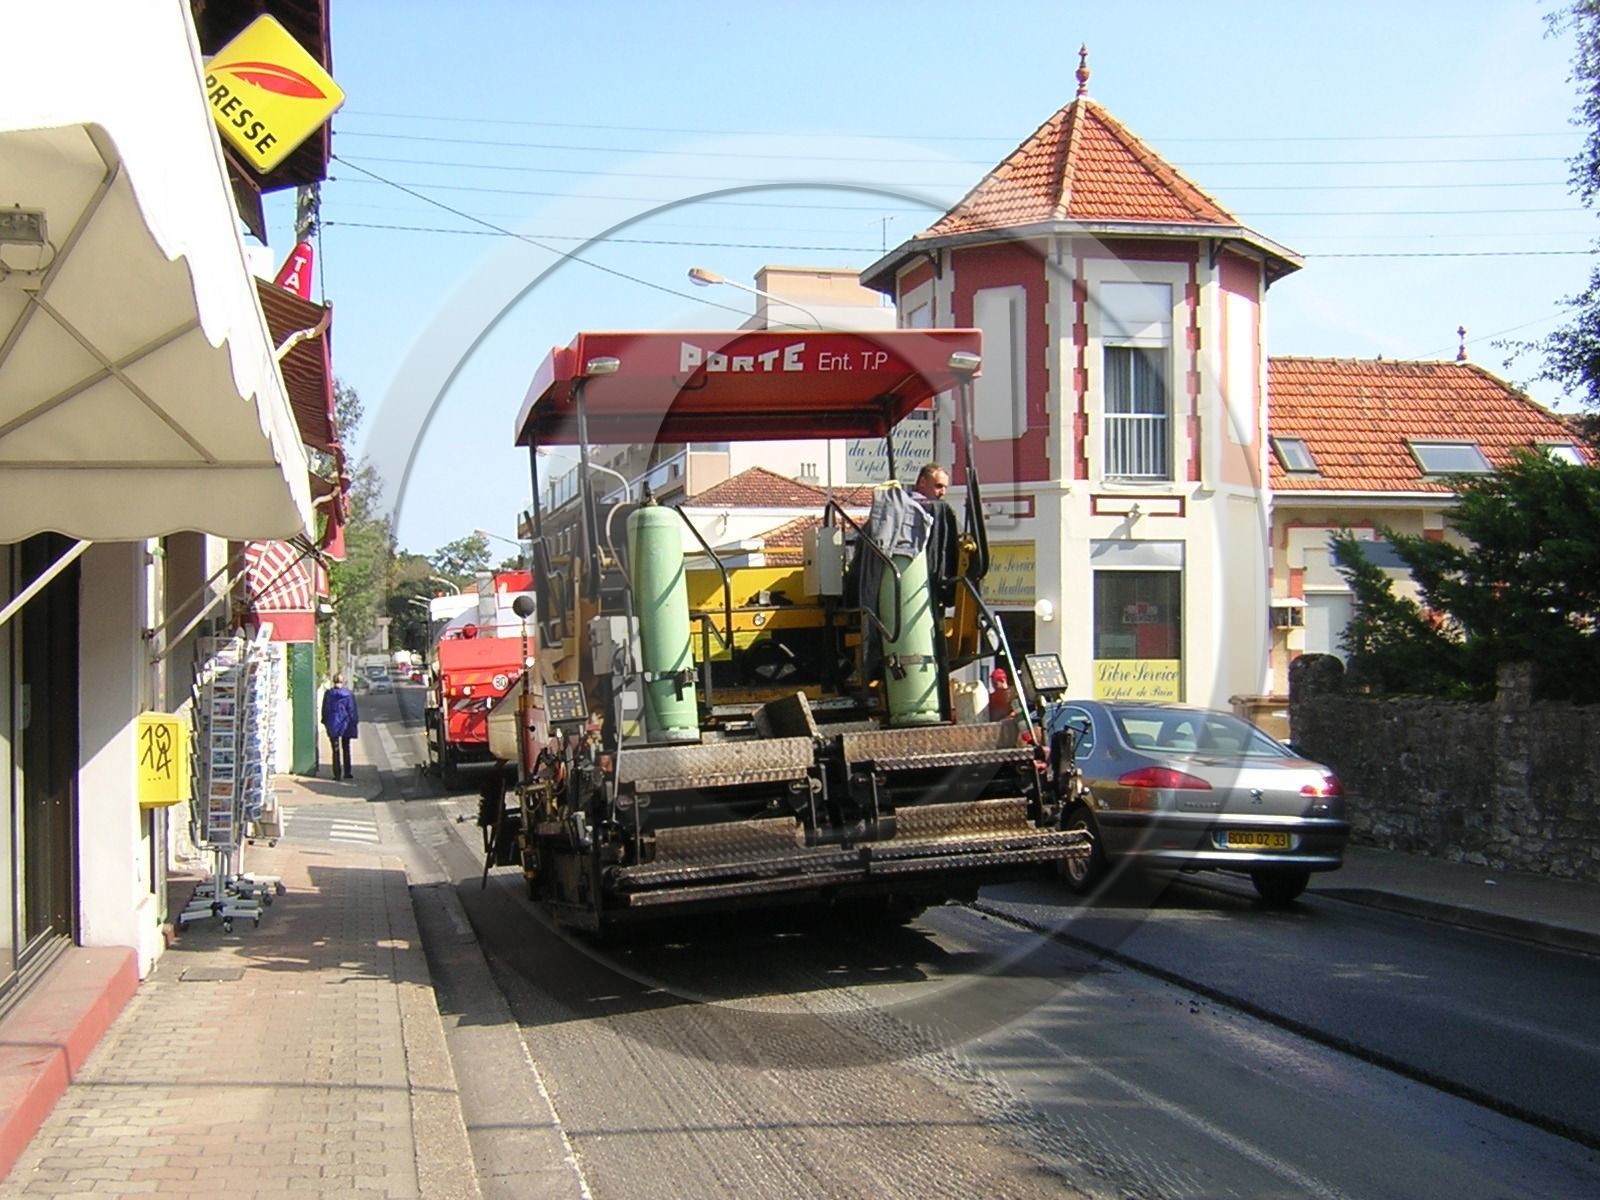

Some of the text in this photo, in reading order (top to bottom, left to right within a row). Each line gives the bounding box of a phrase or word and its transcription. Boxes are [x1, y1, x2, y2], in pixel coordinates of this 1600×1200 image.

[205, 74, 277, 155] PRESSE
[680, 342, 805, 372] PORTE
[818, 352, 853, 370] Ent.
[848, 440, 931, 458] du Mulleau
[1098, 662, 1179, 682] Libre Service
[141, 723, 172, 754] 19
[1273, 834, 1286, 847] 33
